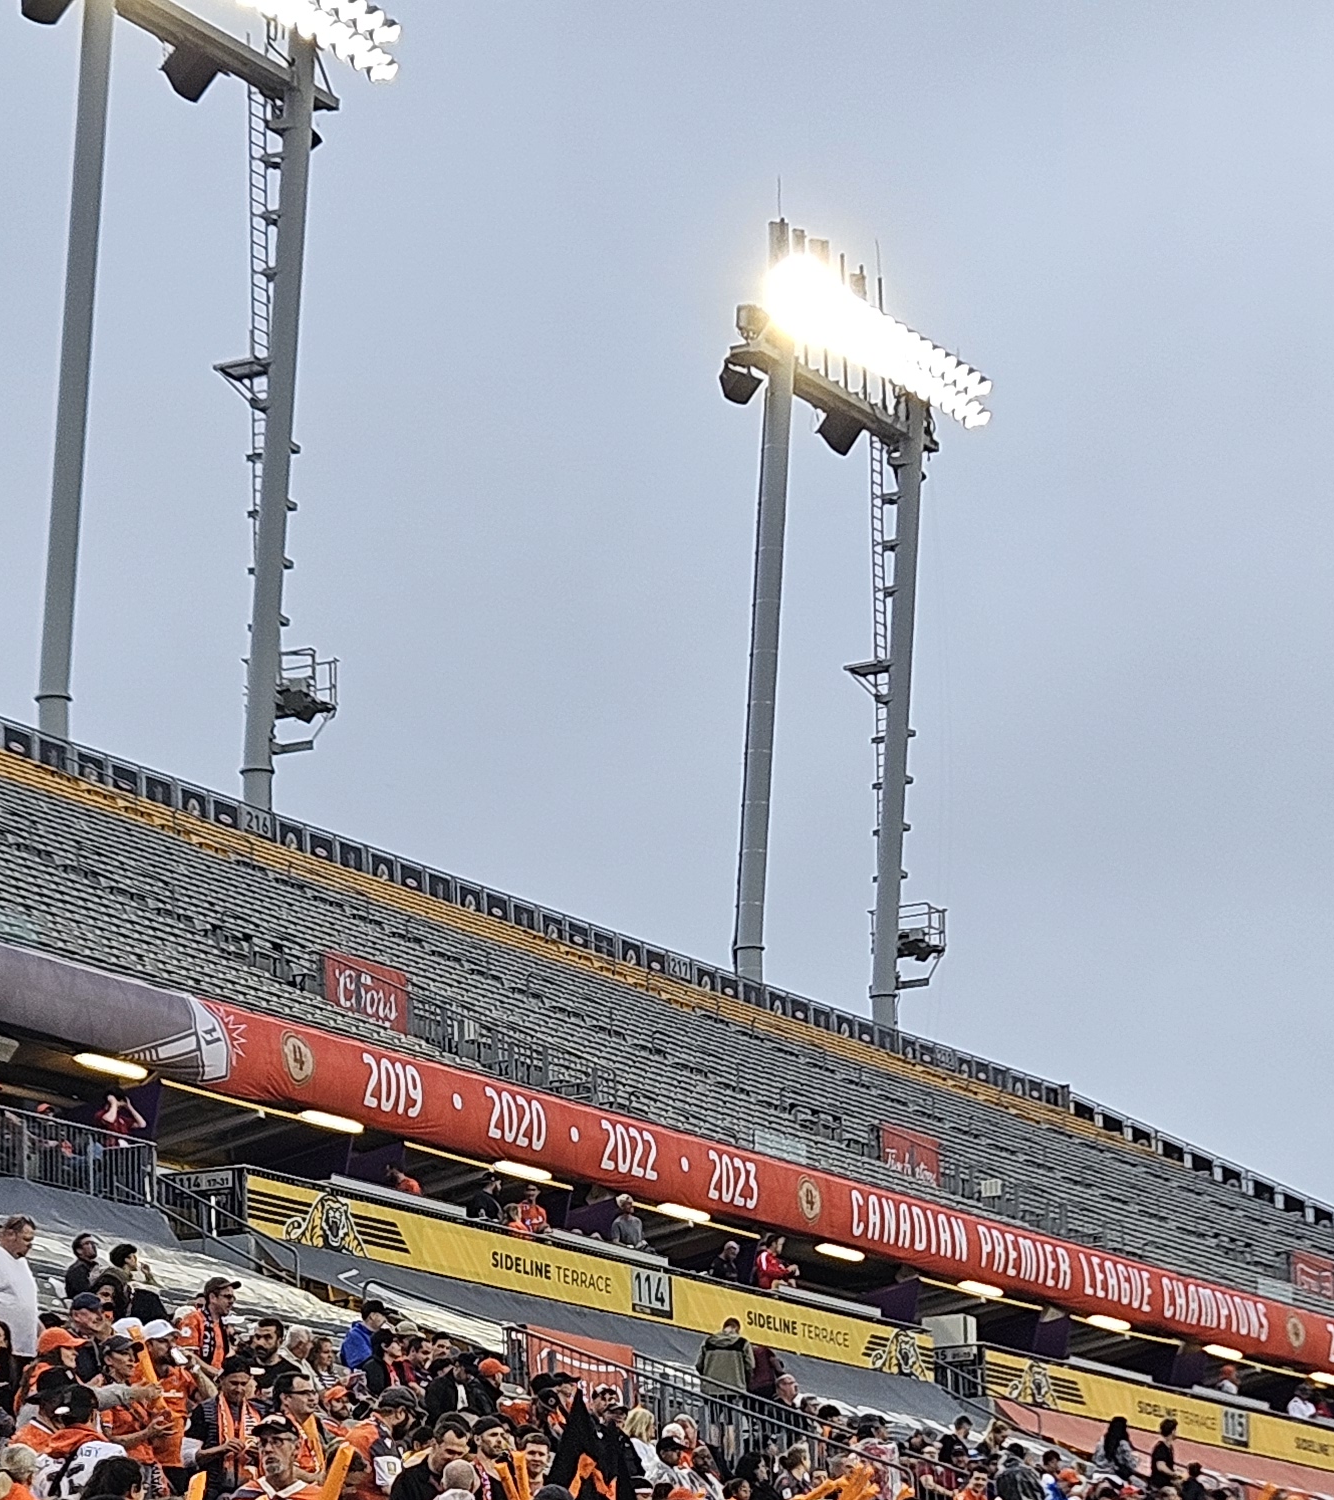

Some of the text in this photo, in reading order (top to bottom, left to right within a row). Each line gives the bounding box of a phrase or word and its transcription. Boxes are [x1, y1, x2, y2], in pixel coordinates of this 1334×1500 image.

[245, 811, 269, 835] 216
[670, 957, 689, 978] 217
[362, 1052, 423, 1118] 2019
[485, 1086, 547, 1151] 2020
[600, 1119, 658, 1181] 2022
[708, 1149, 758, 1209] 2023
[491, 1250, 611, 1294] SIDELINE TERRACE
[851, 1190, 967, 1263] CANADIAN
[977, 1225, 1071, 1291] PREMIER
[1079, 1253, 1151, 1312] LEAGUE
[1161, 1276, 1268, 1342] CHAMPIONS
[634, 1272, 666, 1308] 114
[746, 1310, 850, 1348] SIDELINE TERRACE
